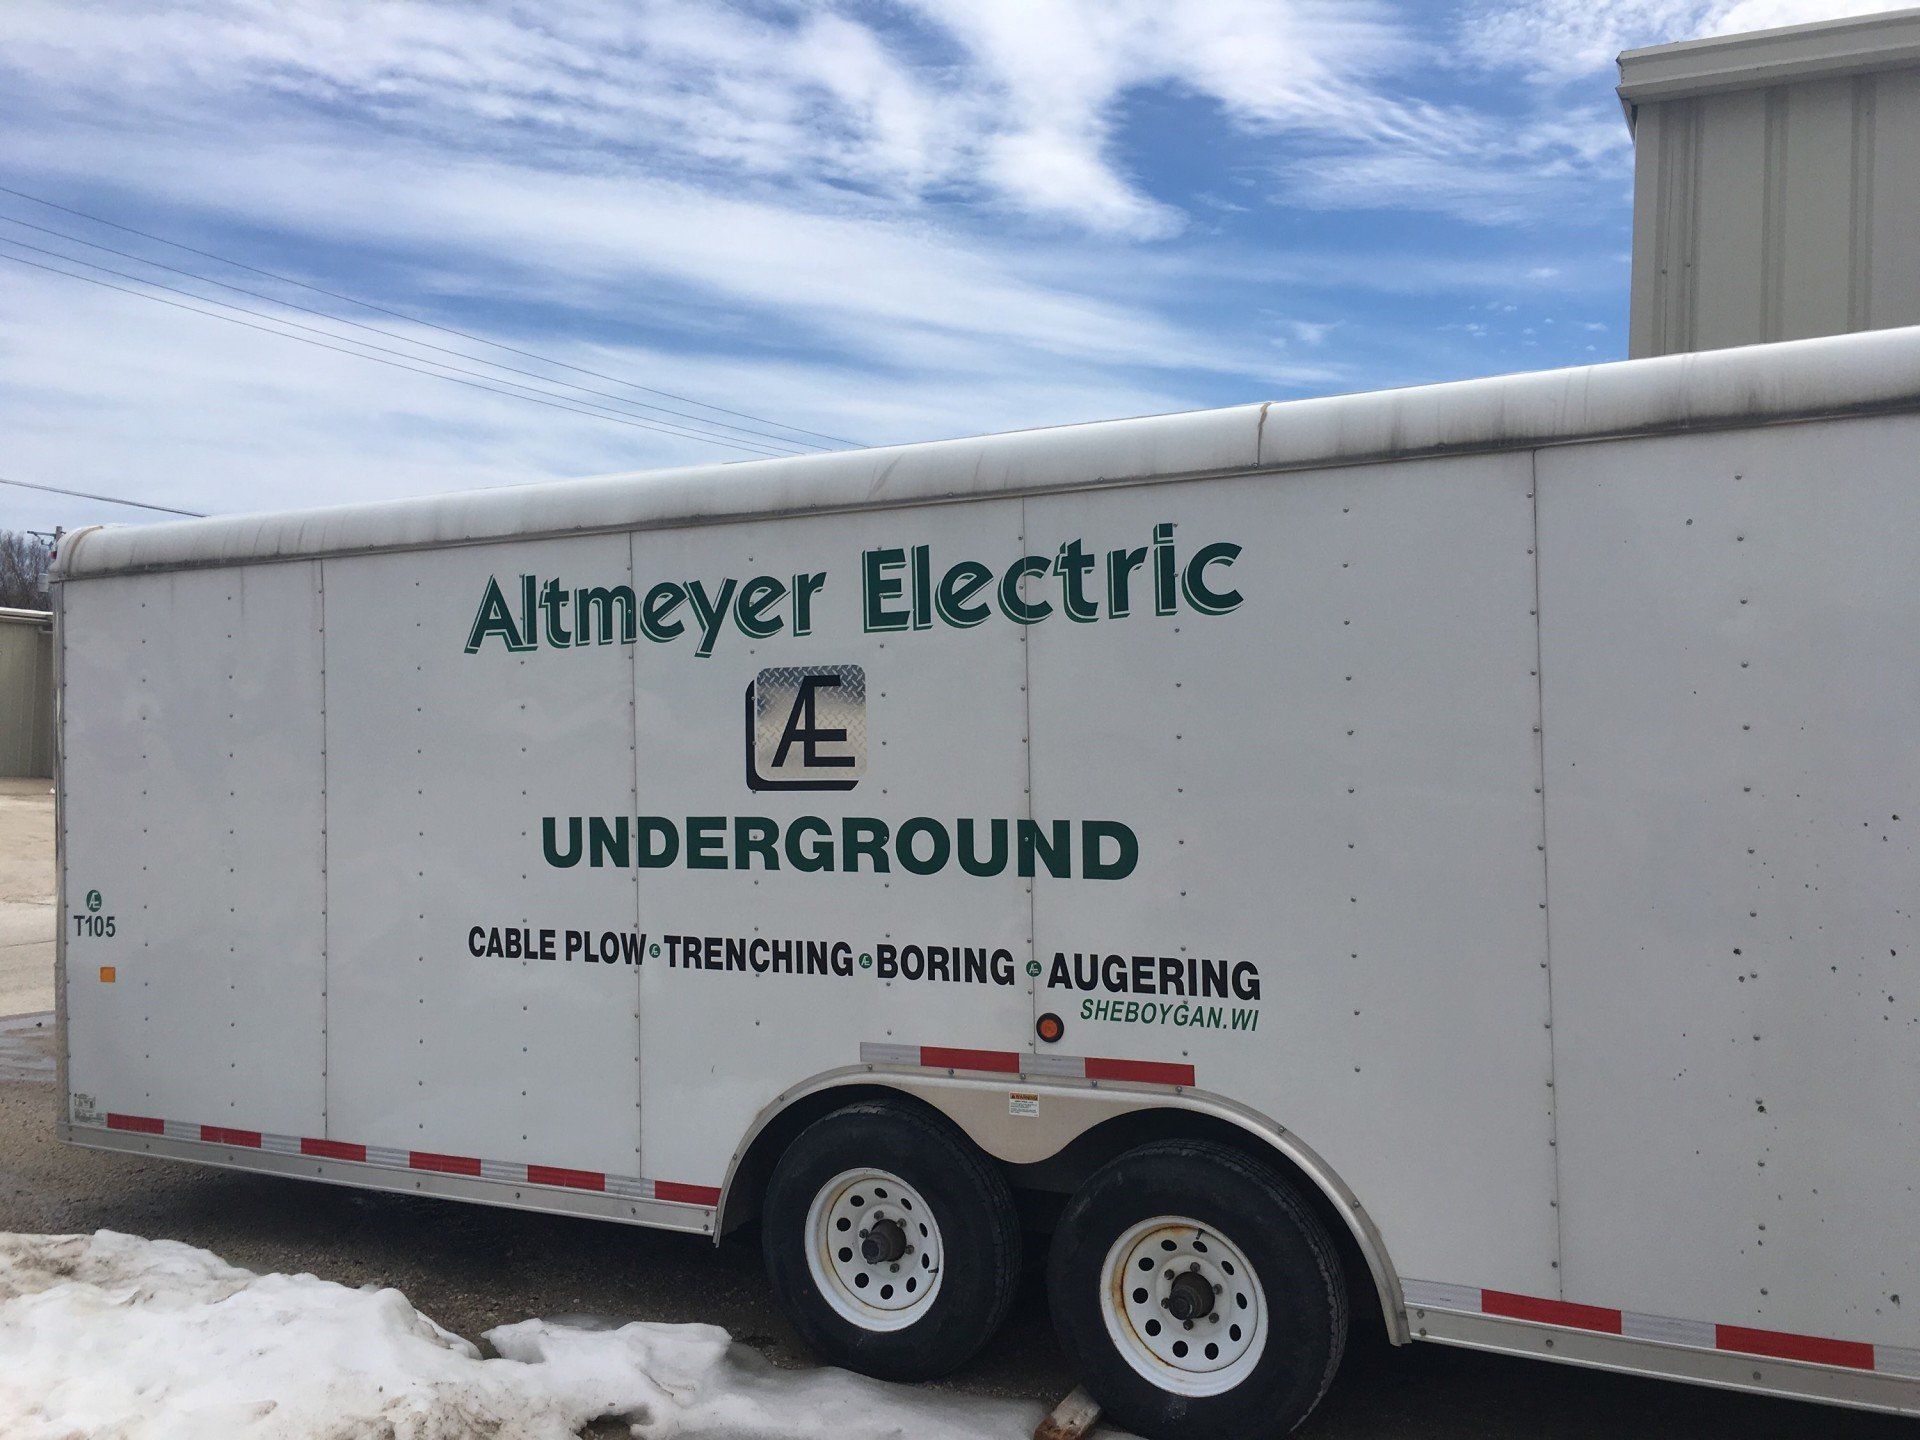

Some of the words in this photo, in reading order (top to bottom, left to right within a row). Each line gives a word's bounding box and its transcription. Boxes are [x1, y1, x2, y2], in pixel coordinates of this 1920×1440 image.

[463, 569, 826, 659] Altmeyer
[861, 522, 1244, 634] Electric
[542, 815, 1139, 881] UNDERGROUND
[74, 914, 116, 938] T105
[468, 925, 557, 961] CABLE
[565, 930, 647, 966] PLOW
[663, 934, 854, 977] TRENCHING
[876, 943, 1015, 986] BORING
[1047, 952, 1261, 1001] AUGERING
[1080, 998, 1260, 1032] SHEBOYGAN.WI
